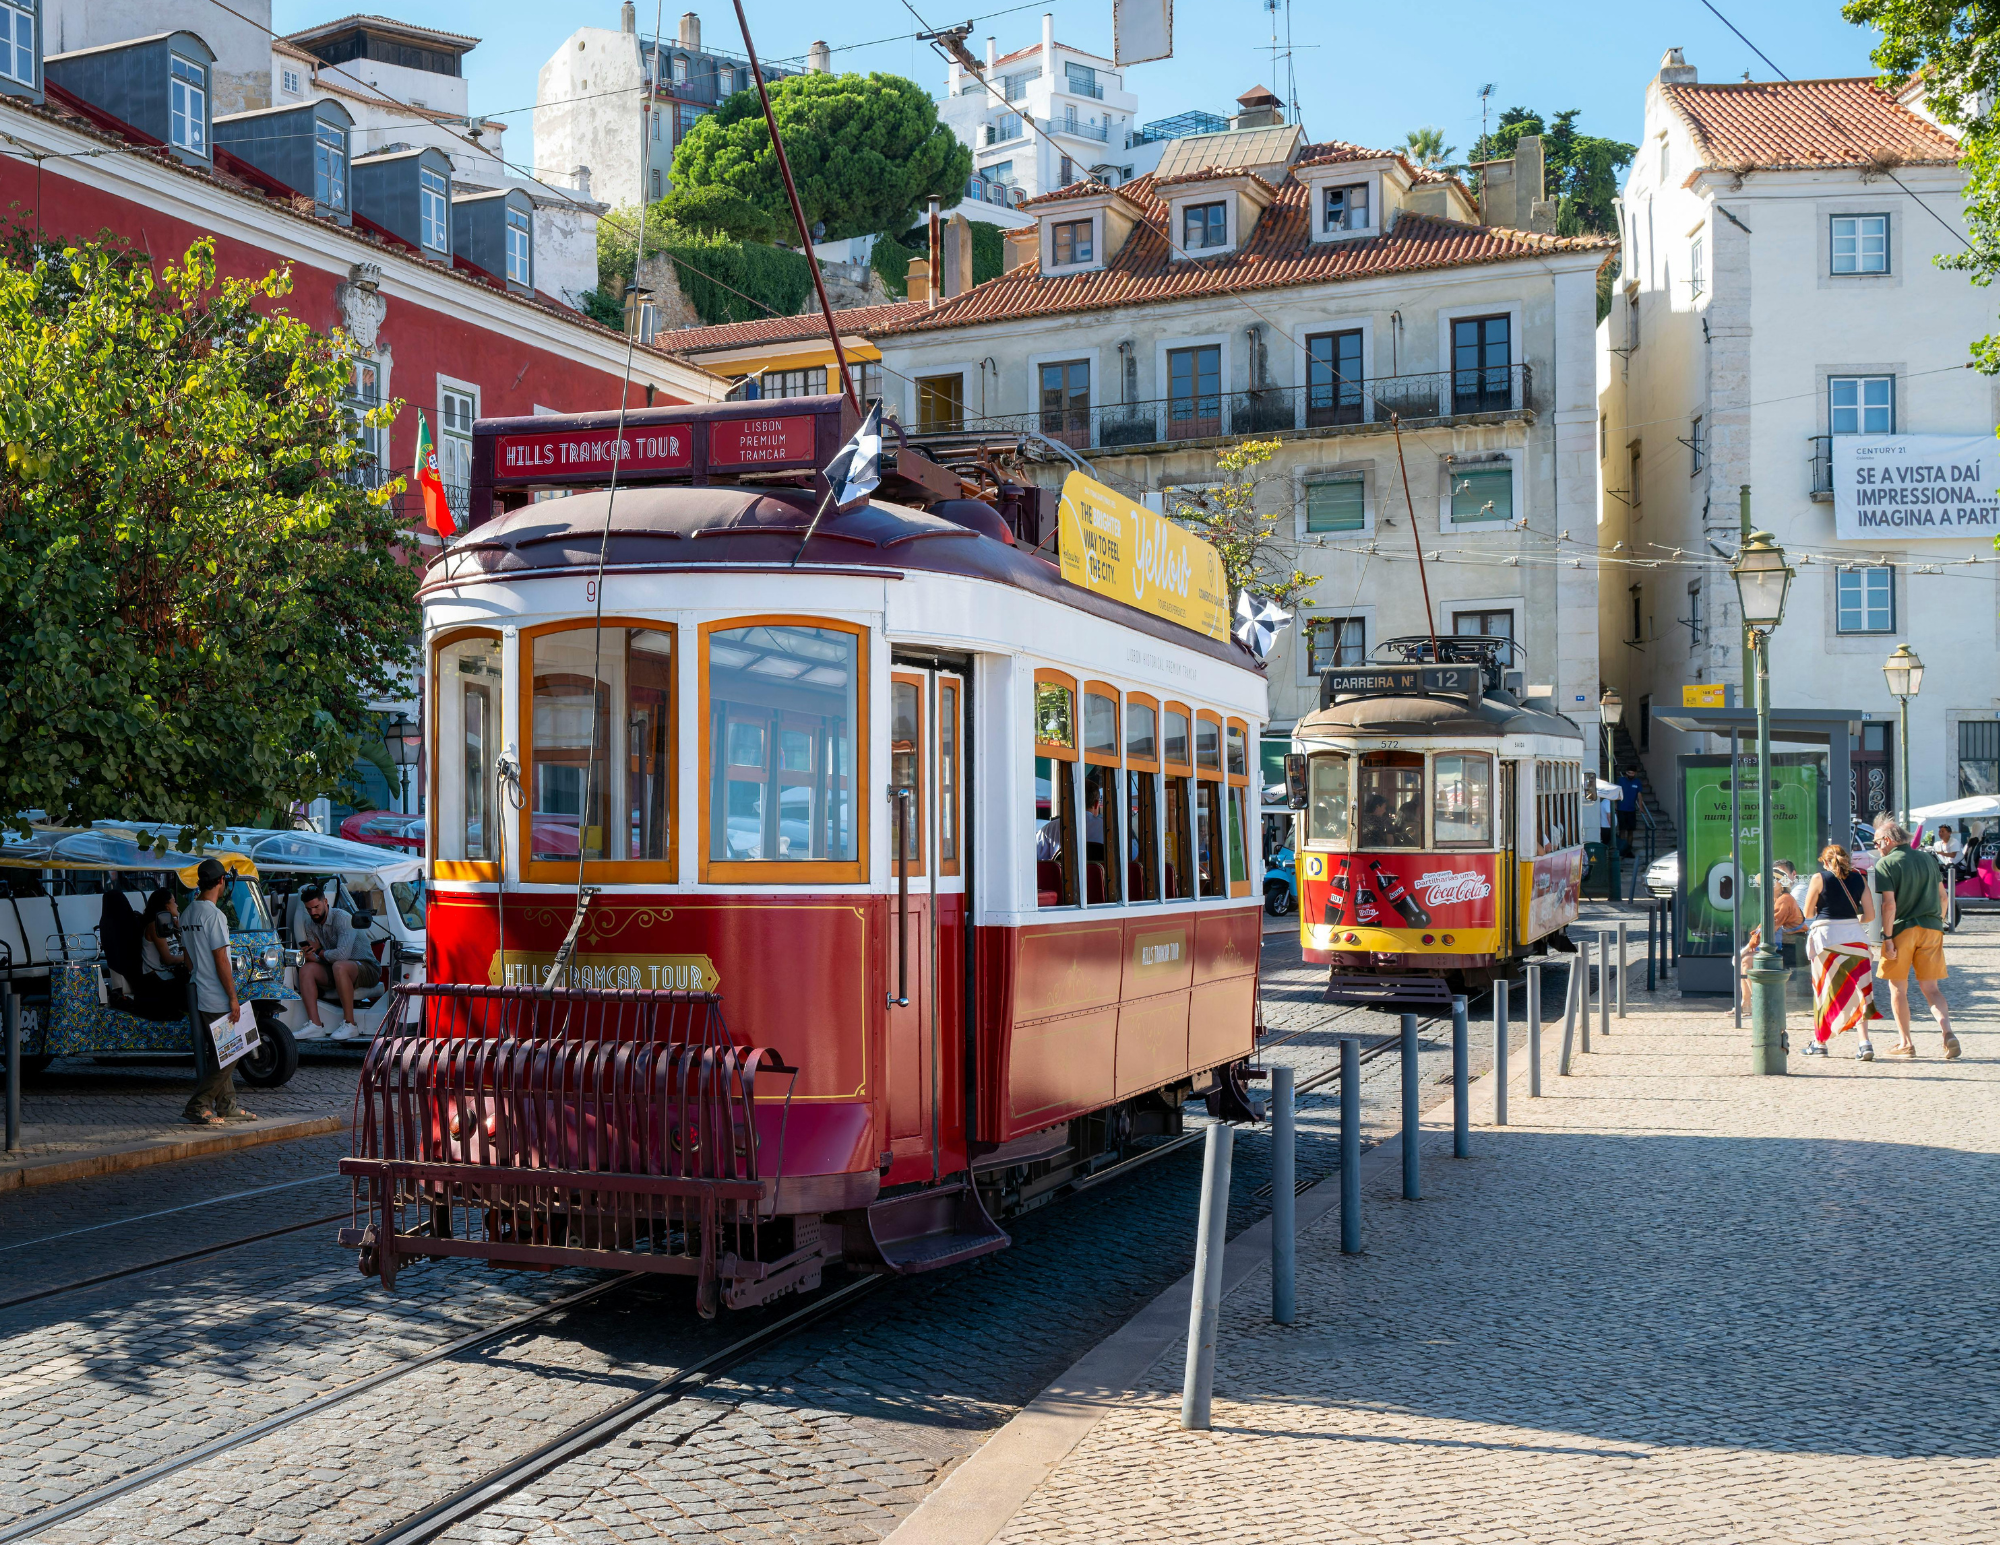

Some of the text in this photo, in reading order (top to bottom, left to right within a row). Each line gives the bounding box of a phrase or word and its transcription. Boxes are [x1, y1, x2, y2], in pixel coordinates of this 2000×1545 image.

[744, 420, 782, 433] LISBON
[740, 434, 787, 447] PREMIUM
[506, 436, 680, 467] HILLS TRAMCAR TOUR
[739, 448, 786, 461] TRAMCAR
[1856, 446, 1906, 455] CENTURY 21
[1856, 458, 1981, 485] SE A VISTA DAÍ
[1080, 501, 1121, 539] THE BRIGHTER
[1858, 509, 1936, 527] IMAGINA
[1940, 508, 1953, 526] A
[1083, 528, 1120, 562] WAY TO FEEL
[1130, 509, 1191, 600] Yellow
[1089, 556, 1101, 579] THE
[586, 581, 596, 602] 9
[1333, 676, 1395, 690] CARREIRA
[1436, 671, 1459, 688] 12
[1381, 740, 1399, 749] 572
[1713, 801, 1728, 811] Vê
[1773, 811, 1799, 820] olhos
[648, 965, 704, 990] TOUR
